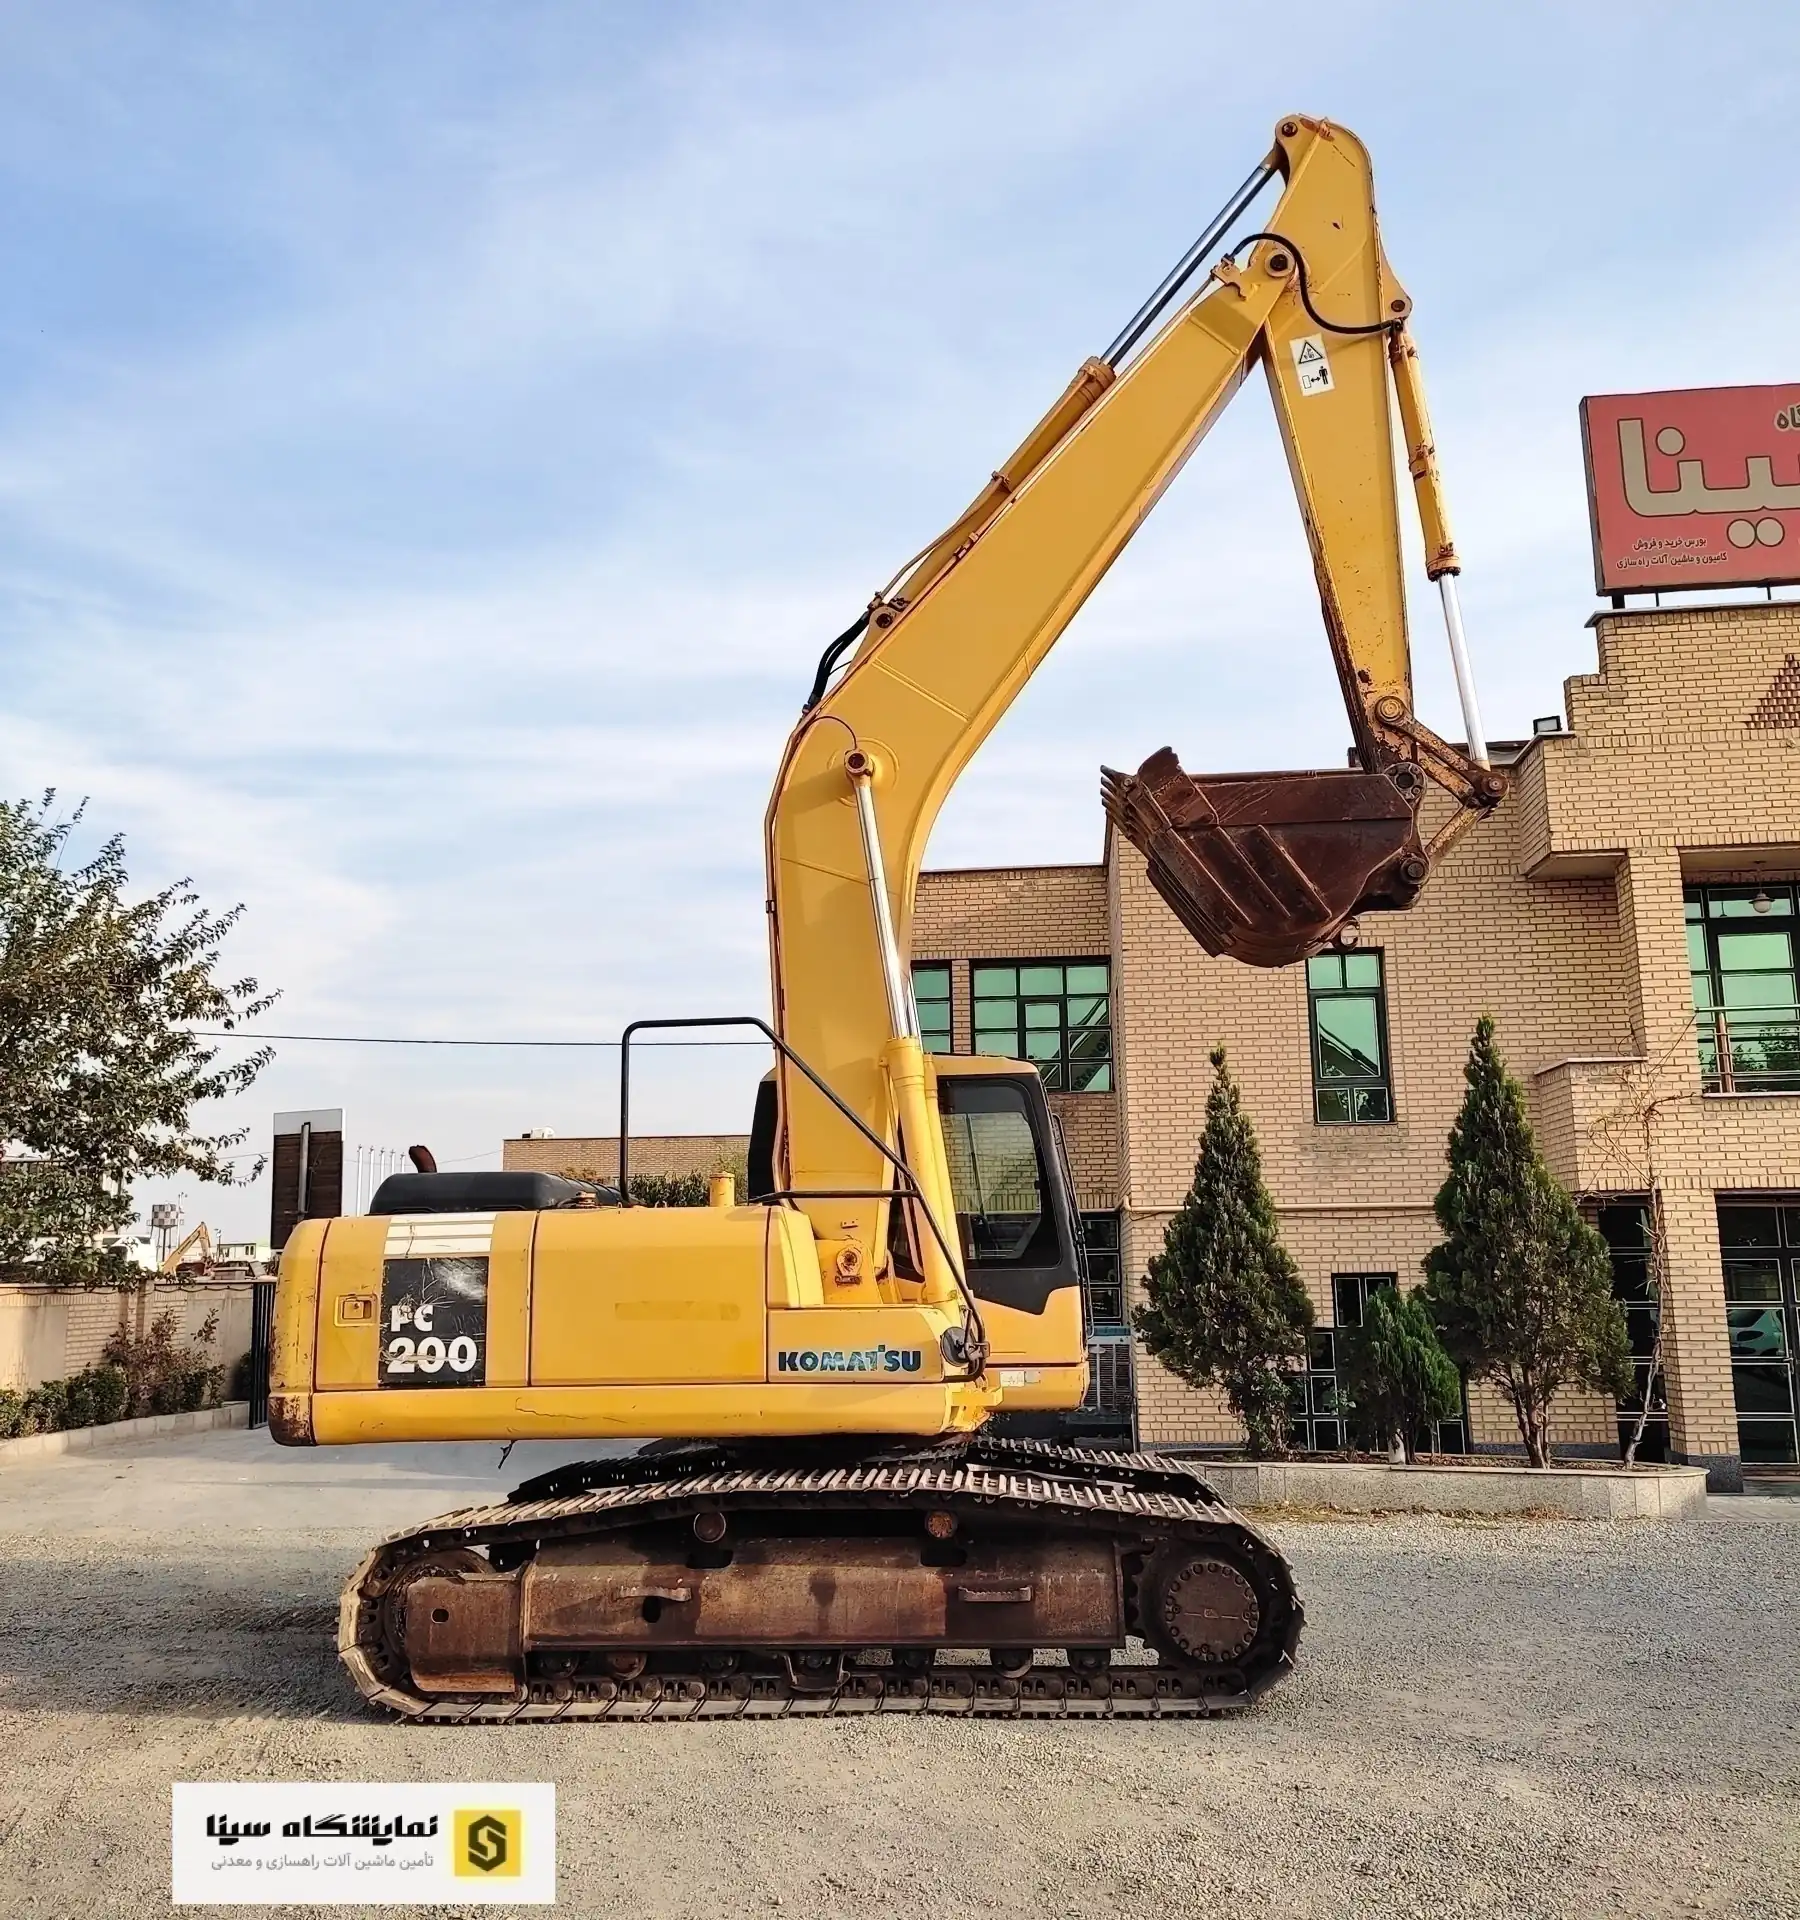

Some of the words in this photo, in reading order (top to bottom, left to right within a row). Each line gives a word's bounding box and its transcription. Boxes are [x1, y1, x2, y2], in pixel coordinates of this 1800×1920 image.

[1617, 417, 1800, 549] ینا
[1633, 538, 1657, 551] فروش
[1658, 540, 1663, 549] و
[1664, 537, 1683, 548] خرید
[1684, 537, 1707, 548] بورس
[1651, 553, 1668, 564] آلات
[1670, 553, 1694, 566] ماشین
[1696, 556, 1700, 564] و
[1702, 552, 1728, 564] کامیون
[391, 1305, 434, 1332] PC
[387, 1336, 478, 1374] 200
[778, 1344, 922, 1373] KOMATSU
